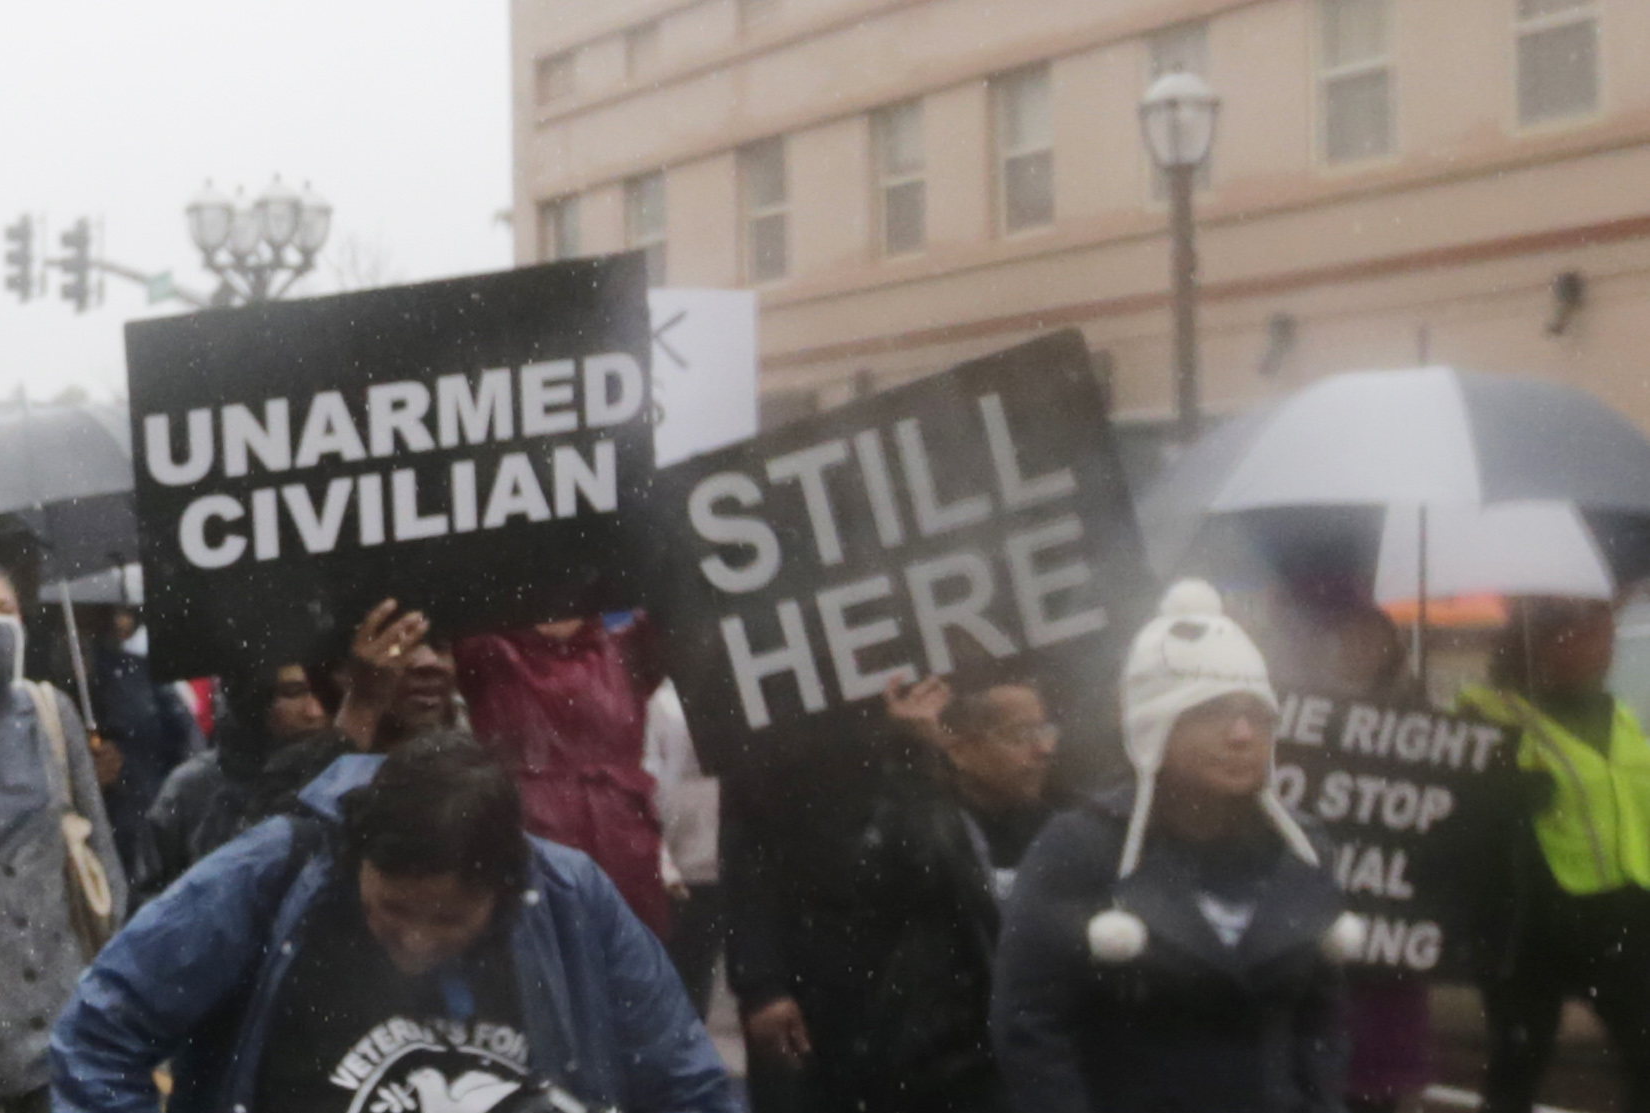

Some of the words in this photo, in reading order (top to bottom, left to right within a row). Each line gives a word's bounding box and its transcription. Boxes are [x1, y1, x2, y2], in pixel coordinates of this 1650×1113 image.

[143, 352, 644, 487] UNARMED
[177, 440, 619, 570] CIVILIAN
[687, 392, 1078, 595] STILL
[719, 512, 1110, 730] HERE
[1272, 764, 1306, 812] O
[1318, 769, 1454, 834] STOP
[1340, 702, 1503, 773] RIGHT
[1332, 842, 1415, 899] IAL
